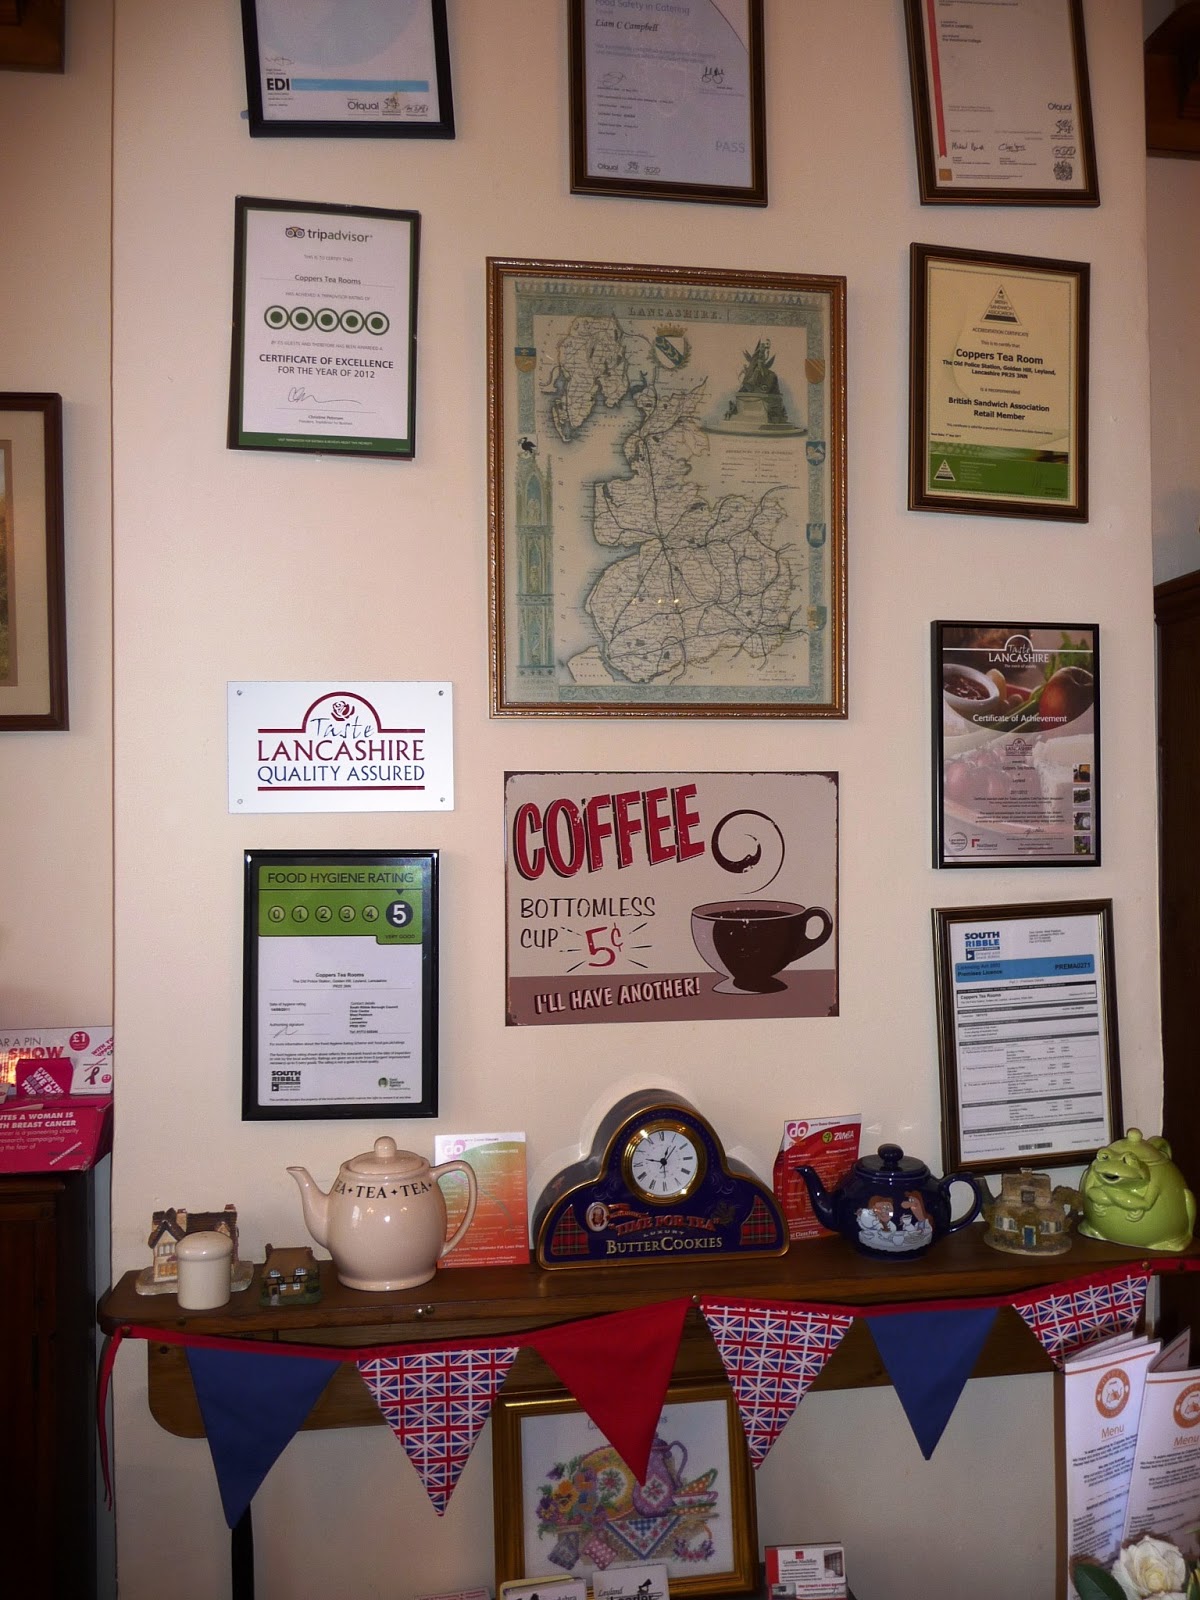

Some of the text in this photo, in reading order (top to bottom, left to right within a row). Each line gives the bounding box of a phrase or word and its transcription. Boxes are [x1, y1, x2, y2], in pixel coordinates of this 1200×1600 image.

[656, 3, 690, 16] Catering
[595, 19, 659, 32] Liam C Campbell
[266, 78, 290, 91] EDI
[347, 101, 380, 112] Ofqual
[1048, 102, 1072, 112] Ofqual
[715, 140, 746, 154] PASS
[307, 228, 368, 244] tripadvisor
[294, 274, 362, 286] Coppers Tea Rooms
[259, 354, 394, 369] CERTIFICATE OF EXCELLENCE
[956, 348, 1044, 364] Coppers Tea Room
[278, 365, 376, 378] FOR THE YEAR OF 2012
[971, 368, 1000, 377] Lancashire
[981, 362, 1002, 371] Station,
[1003, 364, 1022, 372] Golden
[1034, 368, 1056, 376] Leyland,
[948, 396, 1050, 412] British Sandwich Association
[974, 409, 1026, 420] Retail Member
[1008, 644, 1031, 654] Taste
[989, 652, 1050, 663] LANCASHIRE
[973, 714, 1009, 722] Certificate
[1012, 714, 1018, 722] of
[310, 715, 374, 740] Taste
[257, 739, 425, 762] LANCASHIRE
[257, 765, 425, 785] QUALITY ASSURED
[512, 783, 706, 880] COFFEE
[268, 872, 414, 883] FOOD HYGIENE RATING
[520, 896, 656, 918] BOTTOMLESS
[273, 904, 407, 924] 0 1 2 3 4 5
[964, 931, 1000, 940] SOUTH
[520, 922, 624, 968] CUP 5¢
[965, 939, 1000, 947] RIBBLE
[535, 977, 701, 1014] I'LL HAVE ANOTHER!
[13, 1038, 21, 1046] A
[24, 1037, 42, 1046] PIN
[72, 1034, 86, 1042] £1
[8, 1046, 65, 1060] SHOW
[45, 1120, 76, 1128] CANCER
[790, 1127, 806, 1137] do
[27, 1136, 65, 1144] campaigning
[356, 1184, 388, 1199] TEA
[400, 1180, 430, 1198] TEA
[655, 1214, 684, 1227] FOR
[643, 1230, 685, 1238] LUXURY
[1101, 1424, 1125, 1439] Menu
[1173, 1435, 1200, 1446] Menu
[598, 1586, 624, 1597] Leyland
